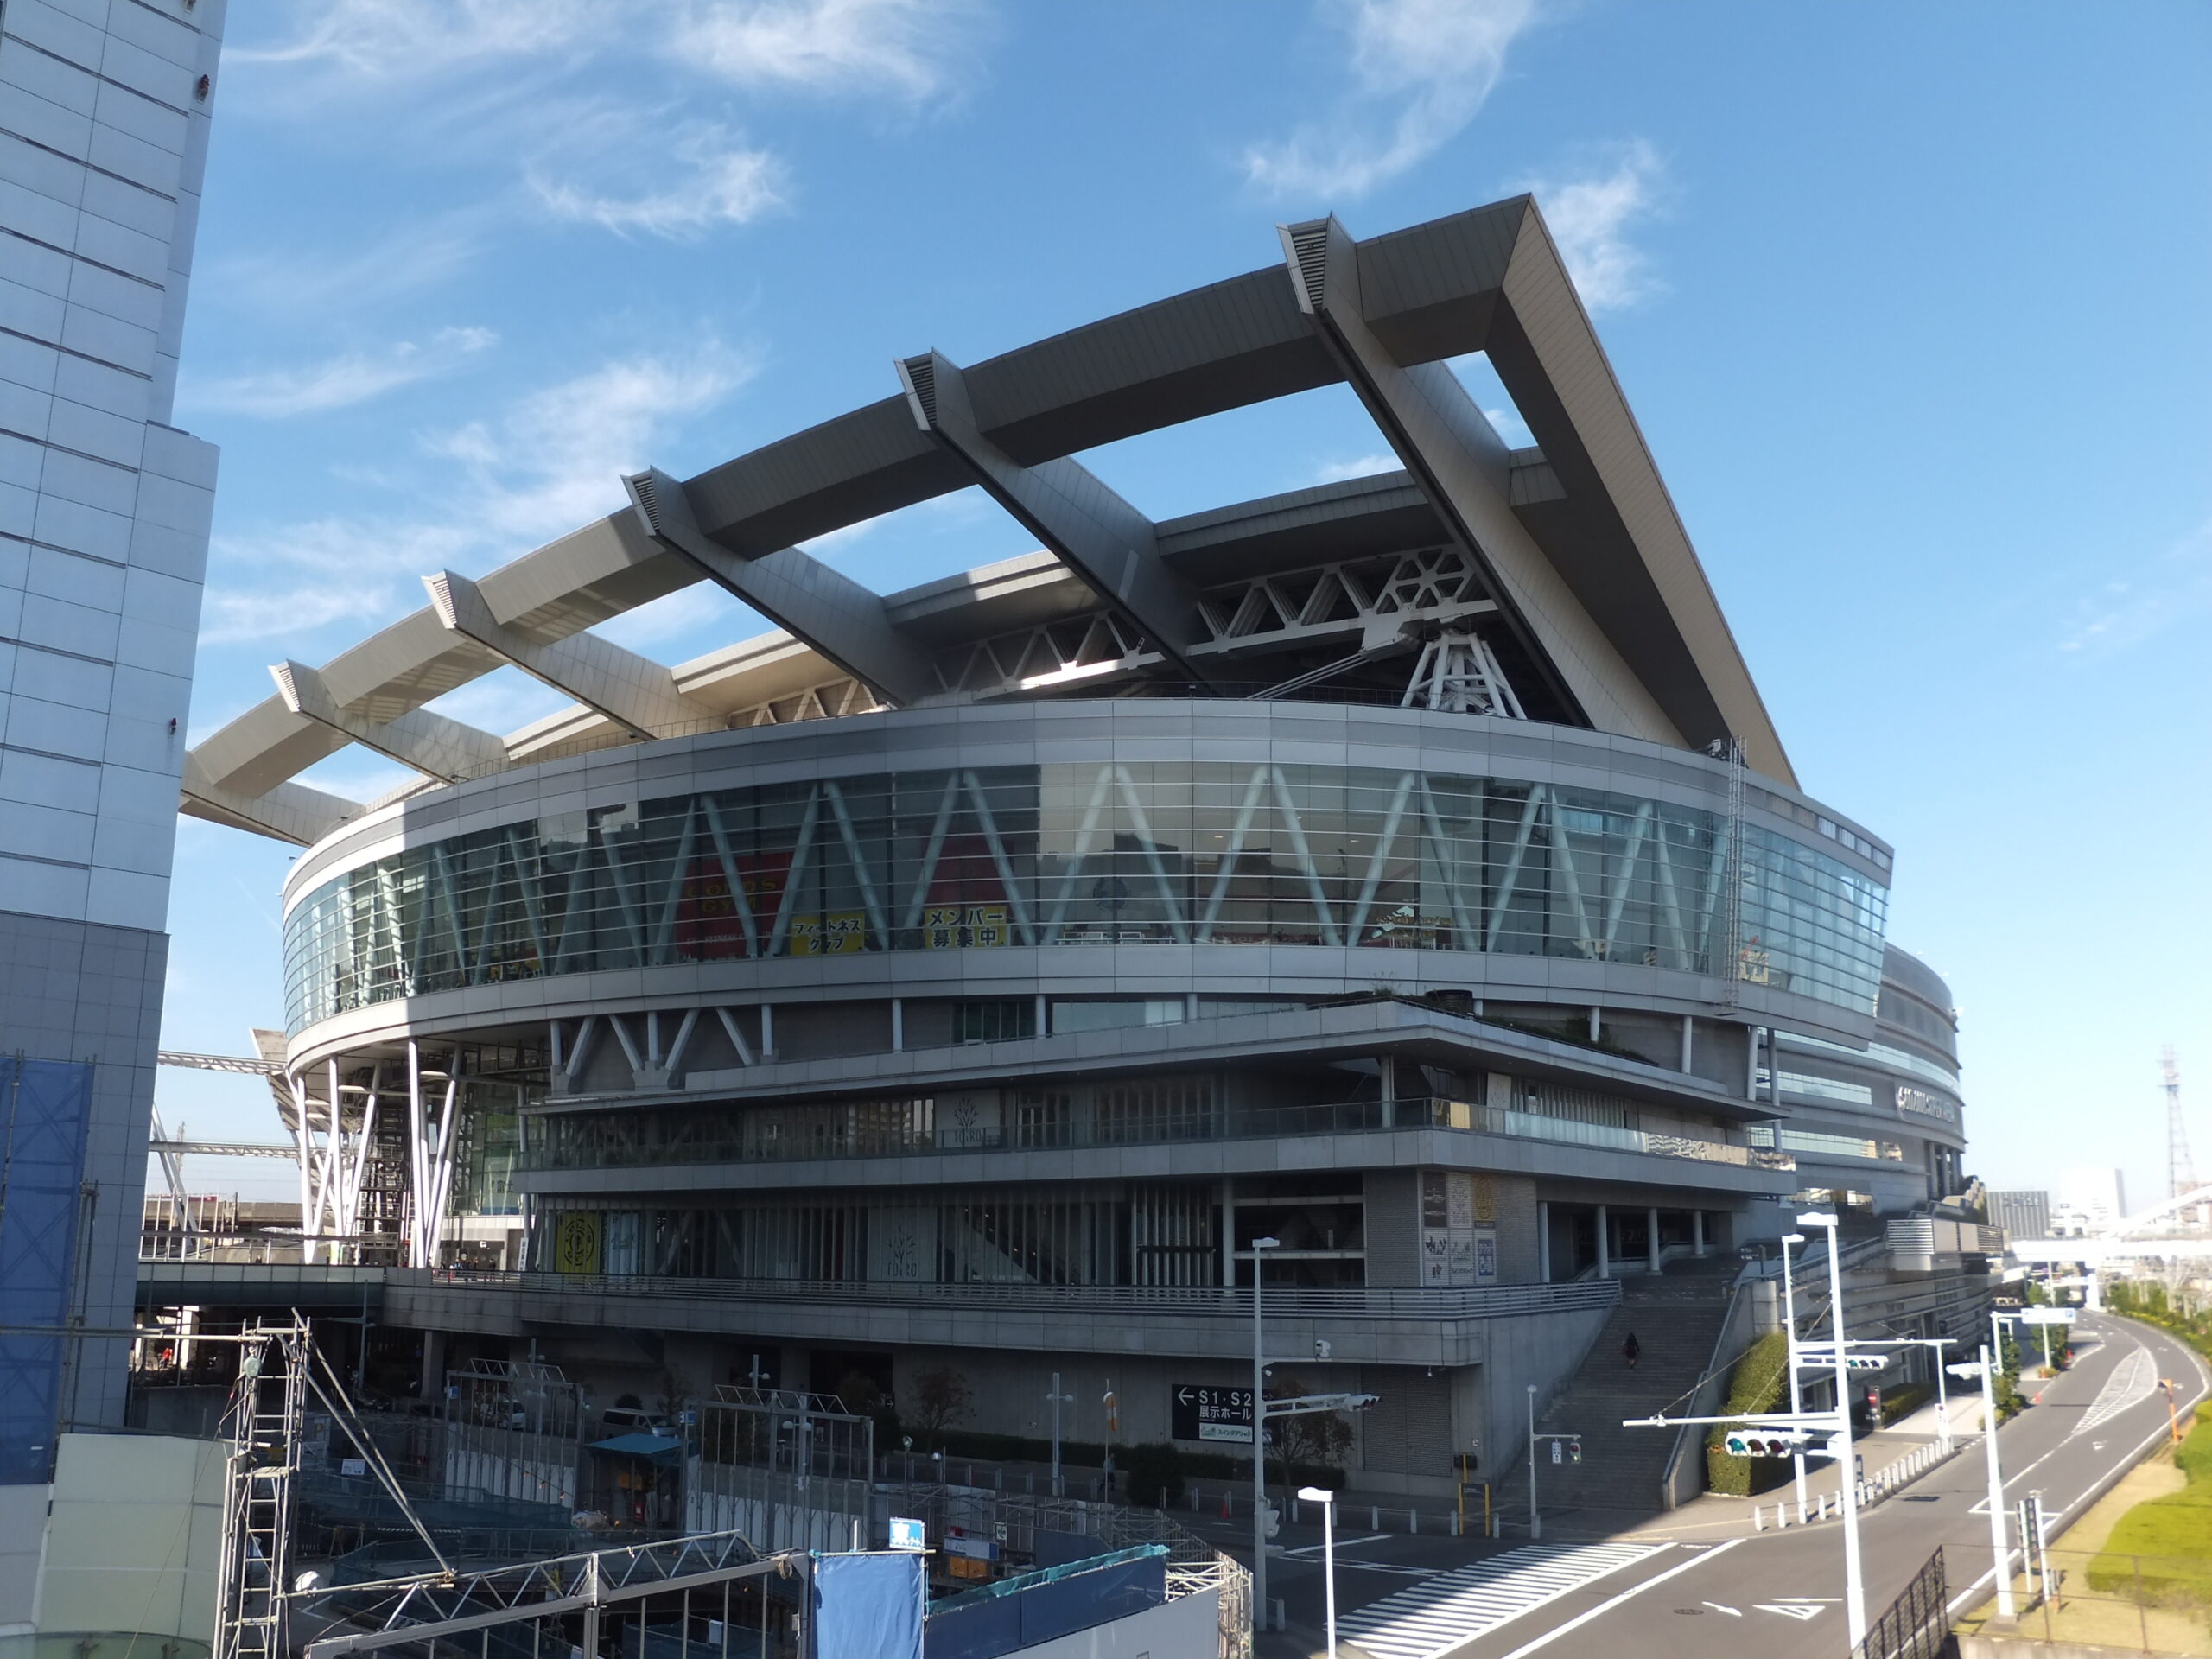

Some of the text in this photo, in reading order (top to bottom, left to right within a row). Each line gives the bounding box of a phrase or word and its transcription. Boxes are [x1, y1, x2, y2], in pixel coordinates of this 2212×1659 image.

[928, 906, 1004, 927] メンバー
[932, 928, 998, 948] 募集中
[1199, 1405, 1252, 1420] 展示ホール
